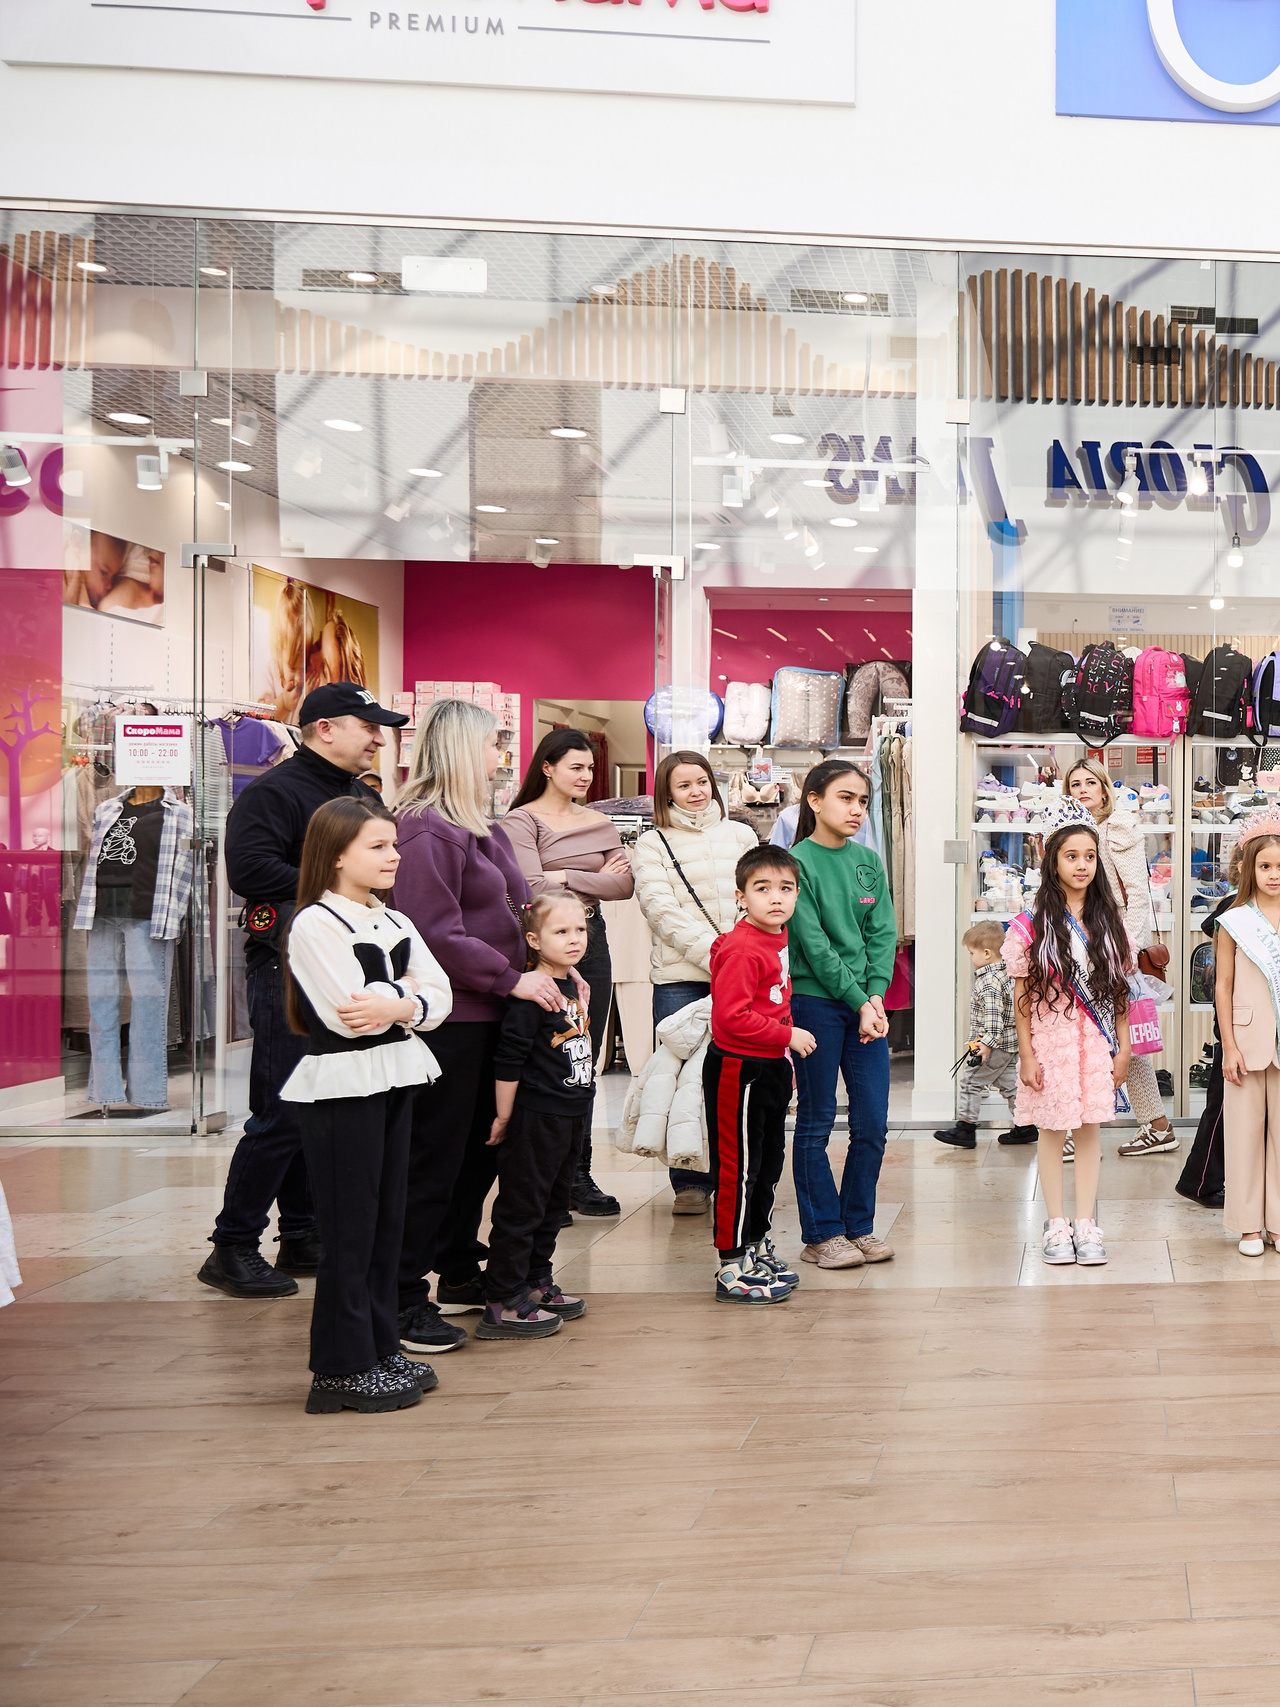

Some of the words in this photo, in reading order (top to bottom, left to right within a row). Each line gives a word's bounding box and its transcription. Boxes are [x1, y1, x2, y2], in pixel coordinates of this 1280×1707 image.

[370, 11, 505, 36] PREMIUM
[125, 726, 181, 737] СкороМама
[129, 749, 149, 757] 10:00
[158, 749, 179, 757] 22:00
